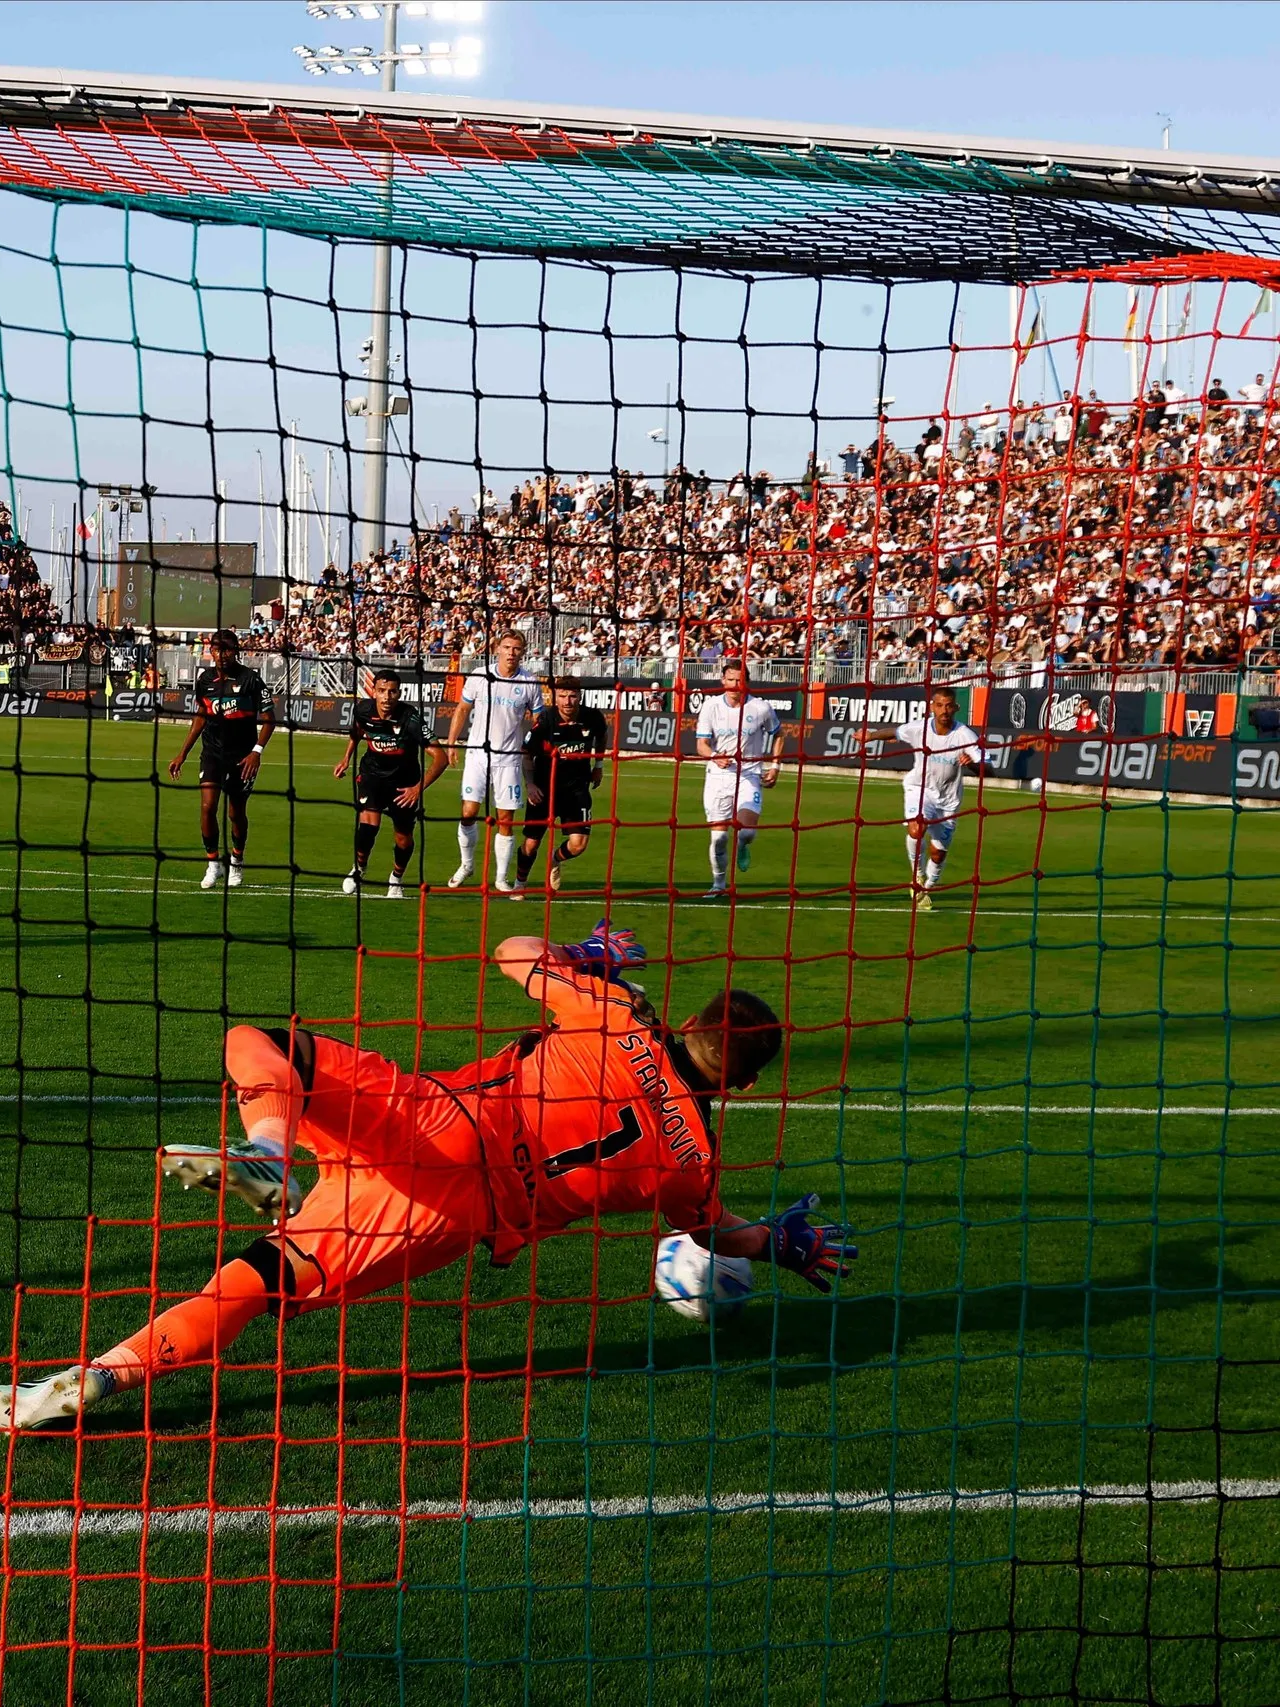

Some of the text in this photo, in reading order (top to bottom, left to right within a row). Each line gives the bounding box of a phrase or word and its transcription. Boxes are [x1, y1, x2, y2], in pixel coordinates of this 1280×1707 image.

[585, 689, 642, 711] VENEZA FC
[848, 699, 906, 723] VENEZIA
[508, 784, 521, 799] 19
[753, 791, 761, 804] 8
[543, 1103, 644, 1181] 1
